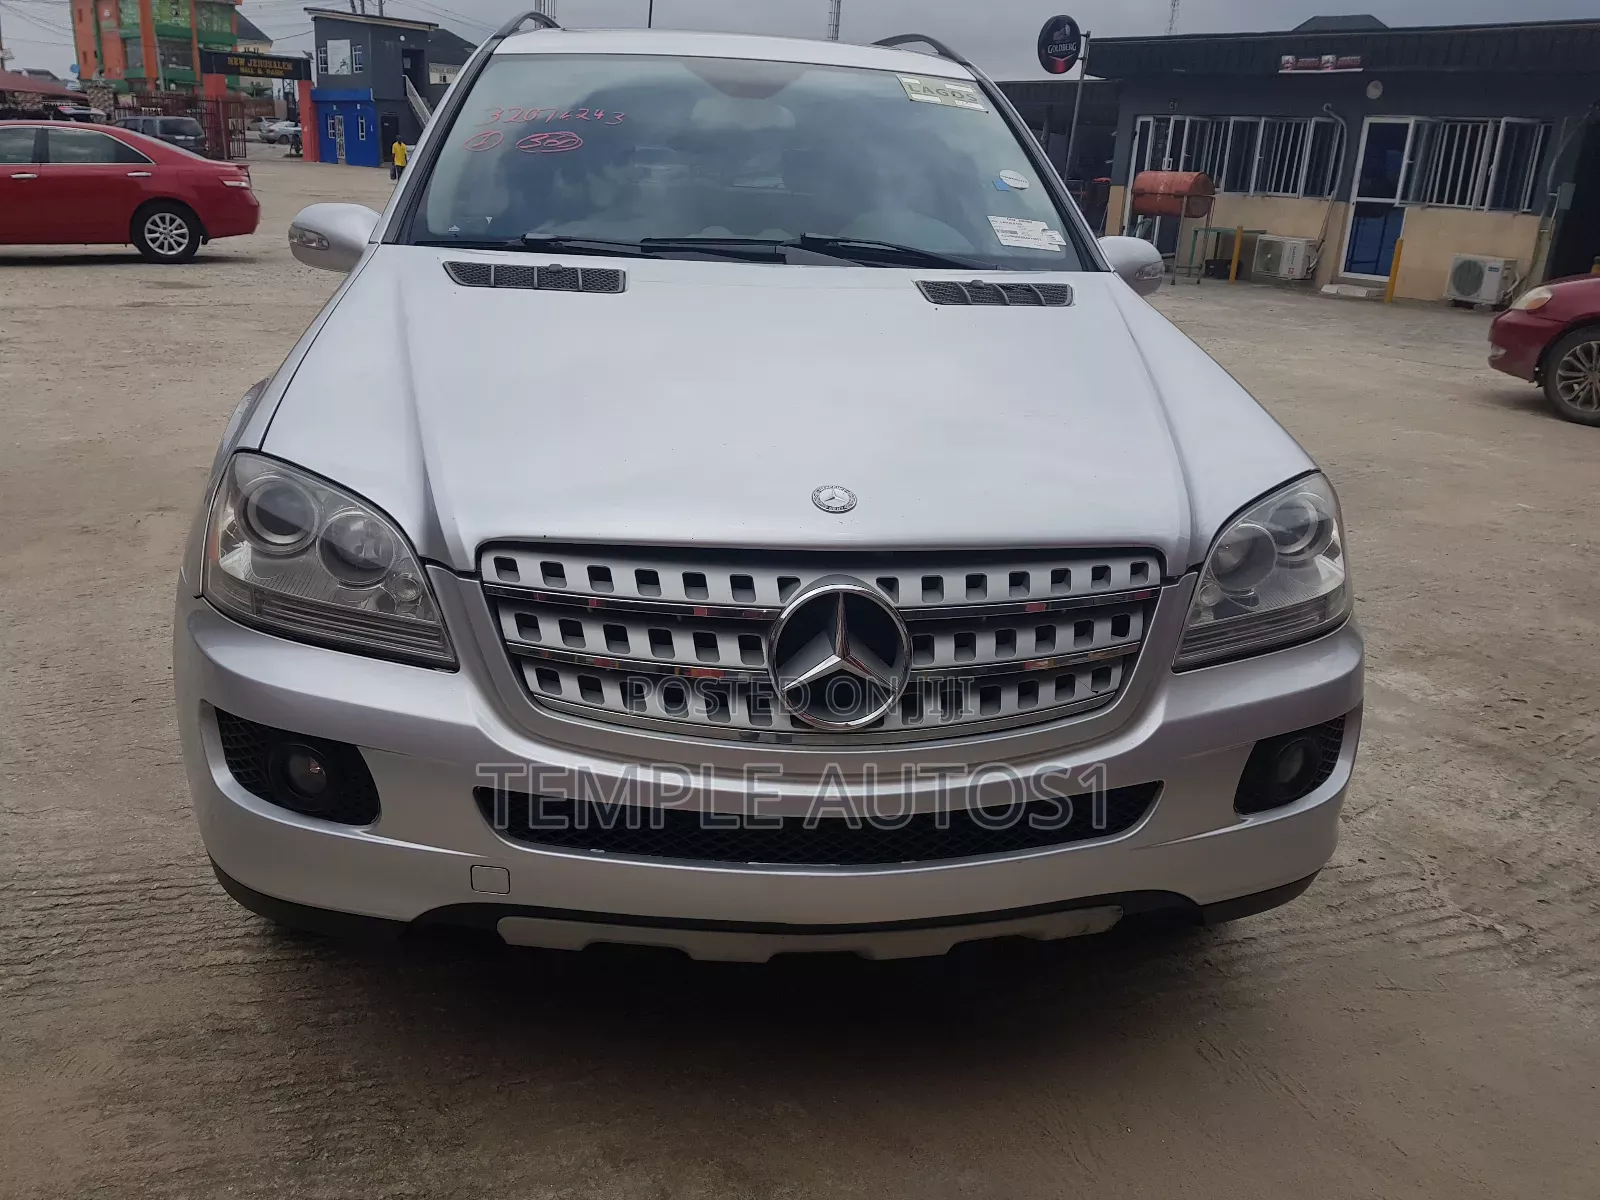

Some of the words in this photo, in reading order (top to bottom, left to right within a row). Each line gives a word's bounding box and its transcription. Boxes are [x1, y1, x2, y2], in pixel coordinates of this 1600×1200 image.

[1047, 42, 1077, 53] GOLDBERG
[227, 56, 245, 66] NEW
[247, 58, 292, 70] JERUSALEM
[907, 83, 978, 102] LAGOS
